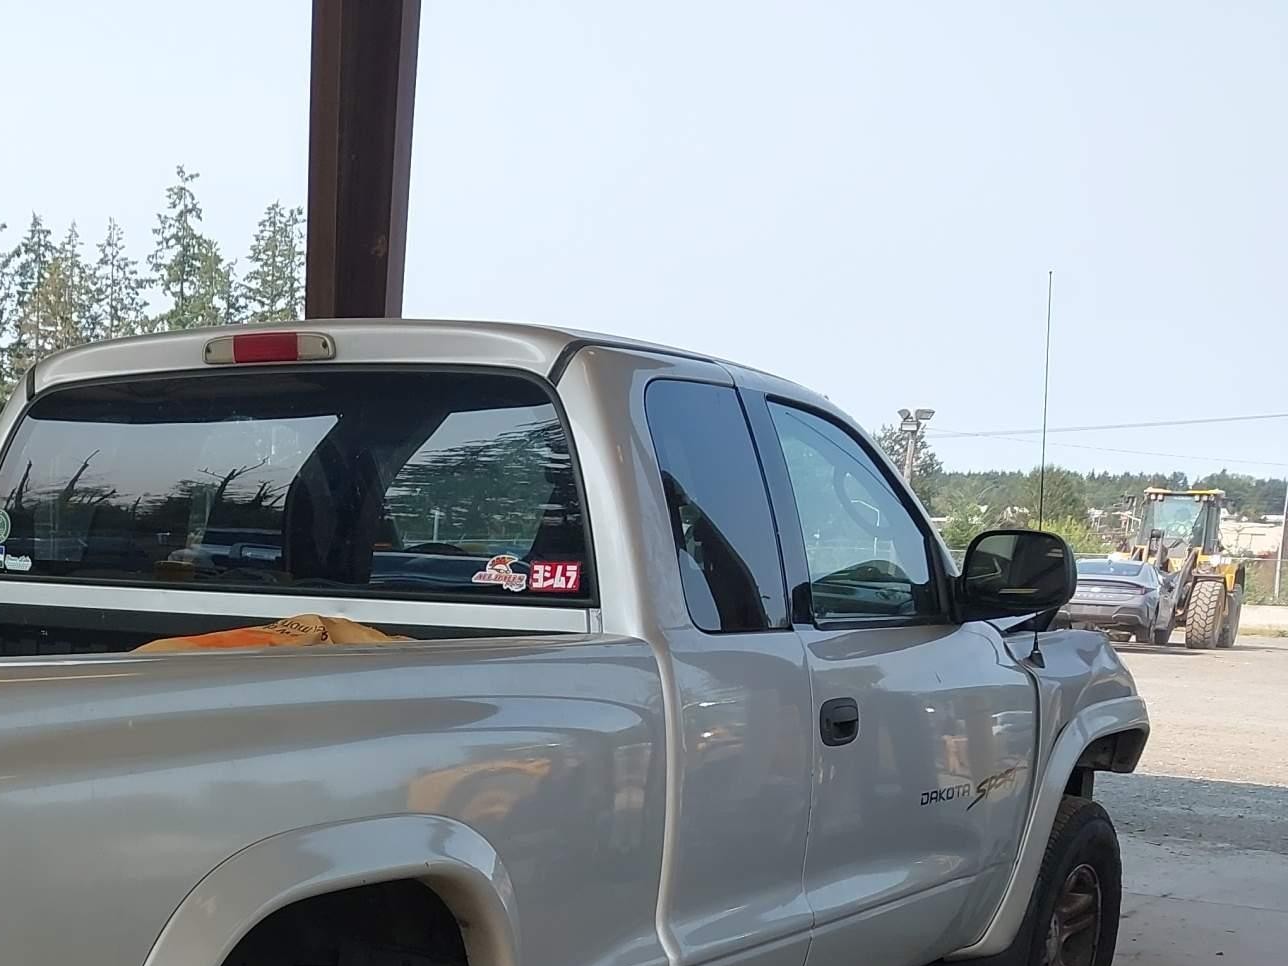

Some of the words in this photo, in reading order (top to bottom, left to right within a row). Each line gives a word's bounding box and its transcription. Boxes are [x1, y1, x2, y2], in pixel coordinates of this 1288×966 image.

[532, 564, 578, 589] ヨシムラ
[920, 783, 971, 806] DAKOTA
